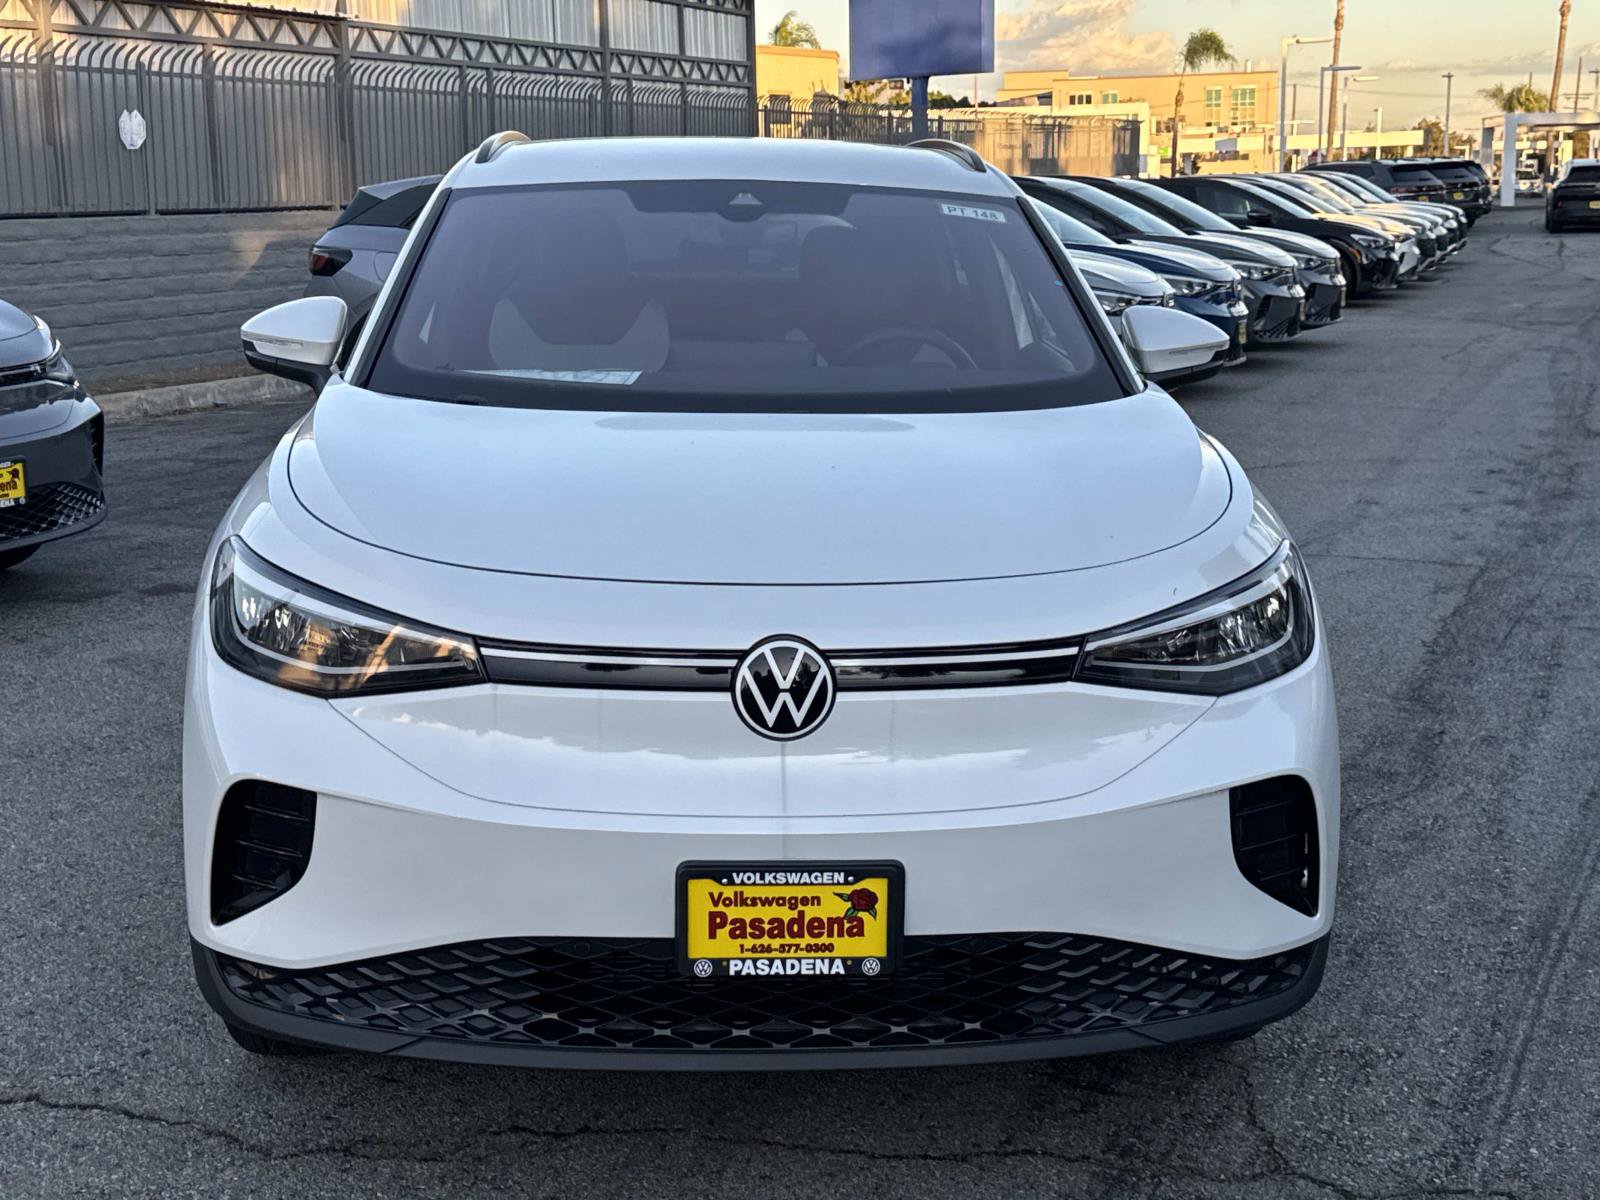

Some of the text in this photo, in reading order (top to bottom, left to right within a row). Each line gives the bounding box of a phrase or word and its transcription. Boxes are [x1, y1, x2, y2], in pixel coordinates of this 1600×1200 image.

[946, 206, 966, 216] PT
[732, 872, 845, 885] VOLKSWAGEN
[708, 891, 822, 911] Volkswagen
[708, 910, 865, 940] Pasadena
[729, 959, 845, 976] PASADENA
